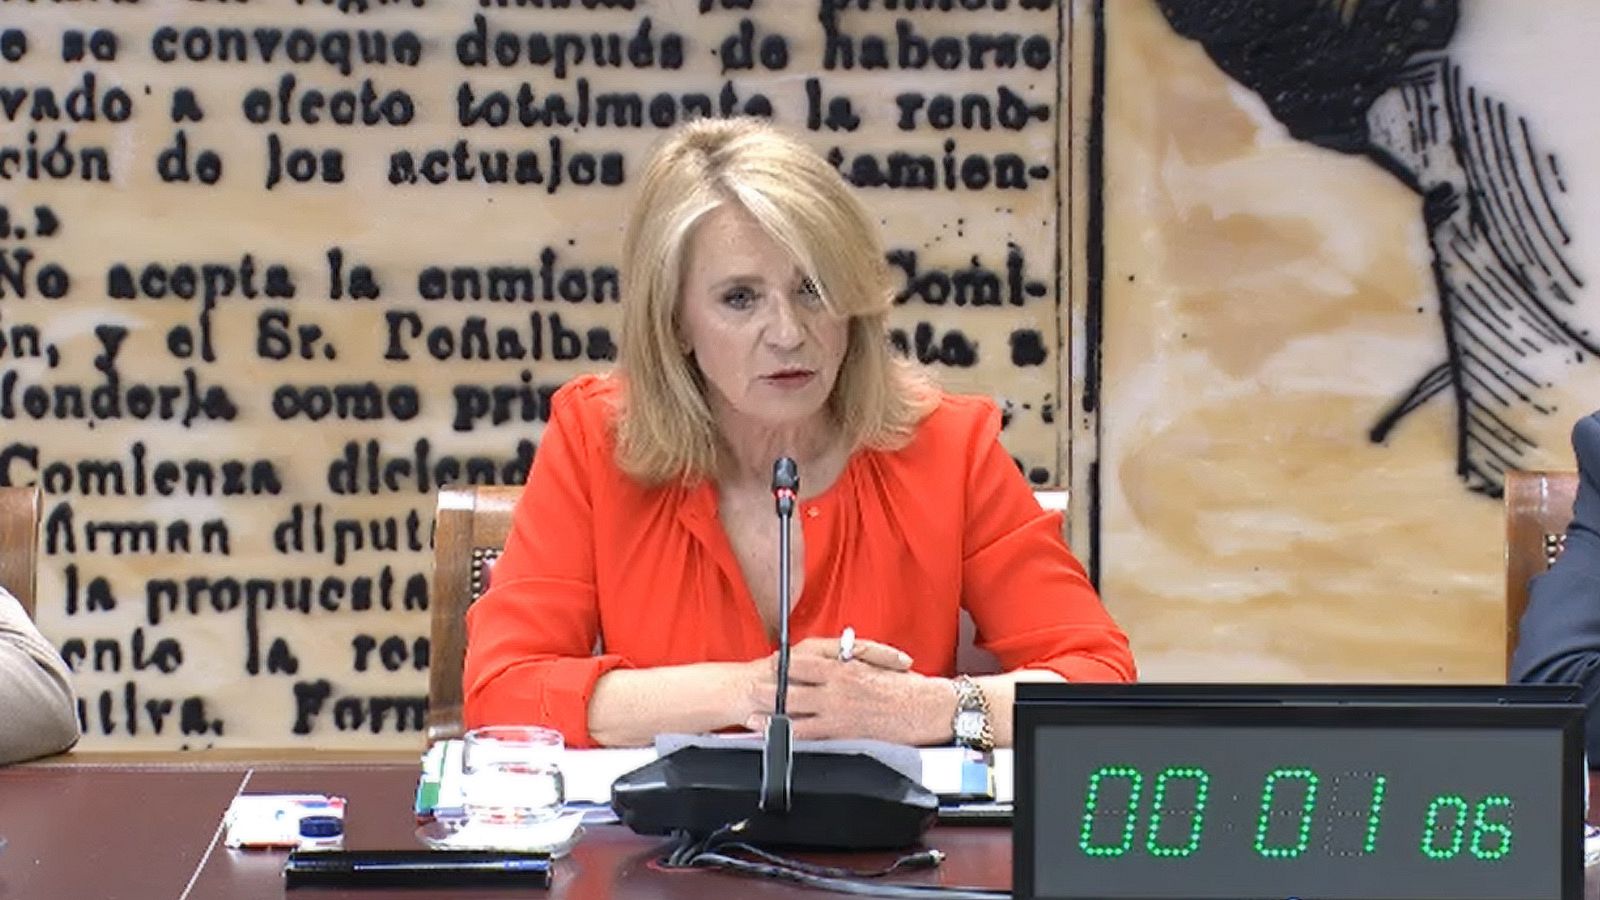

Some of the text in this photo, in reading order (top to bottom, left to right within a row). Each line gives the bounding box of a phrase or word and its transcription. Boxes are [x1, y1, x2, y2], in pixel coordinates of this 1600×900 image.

[151, 26, 425, 78] convoque
[456, 13, 686, 80] después
[717, 18, 792, 74] de
[821, 16, 1053, 72] haberse
[0, 71, 133, 124] vado
[171, 88, 205, 124] a
[242, 73, 416, 127] efecto
[456, 77, 775, 130] totalmente
[804, 77, 862, 133] la
[156, 129, 223, 186] de
[265, 133, 346, 191] los
[387, 135, 626, 195] actuales
[0, 247, 72, 300] No
[107, 253, 297, 306] acepta
[326, 247, 382, 301] la
[94, 324, 129, 371] y
[166, 306, 215, 362] el
[256, 308, 338, 362] Sr.
[271, 381, 421, 422] como
[0, 441, 283, 497] Comienza
[273, 502, 437, 567] diput
[64, 563, 430, 627] la propuesta
[246, 628, 299, 676] la
[1079, 766, 1512, 860] 00 01 06
